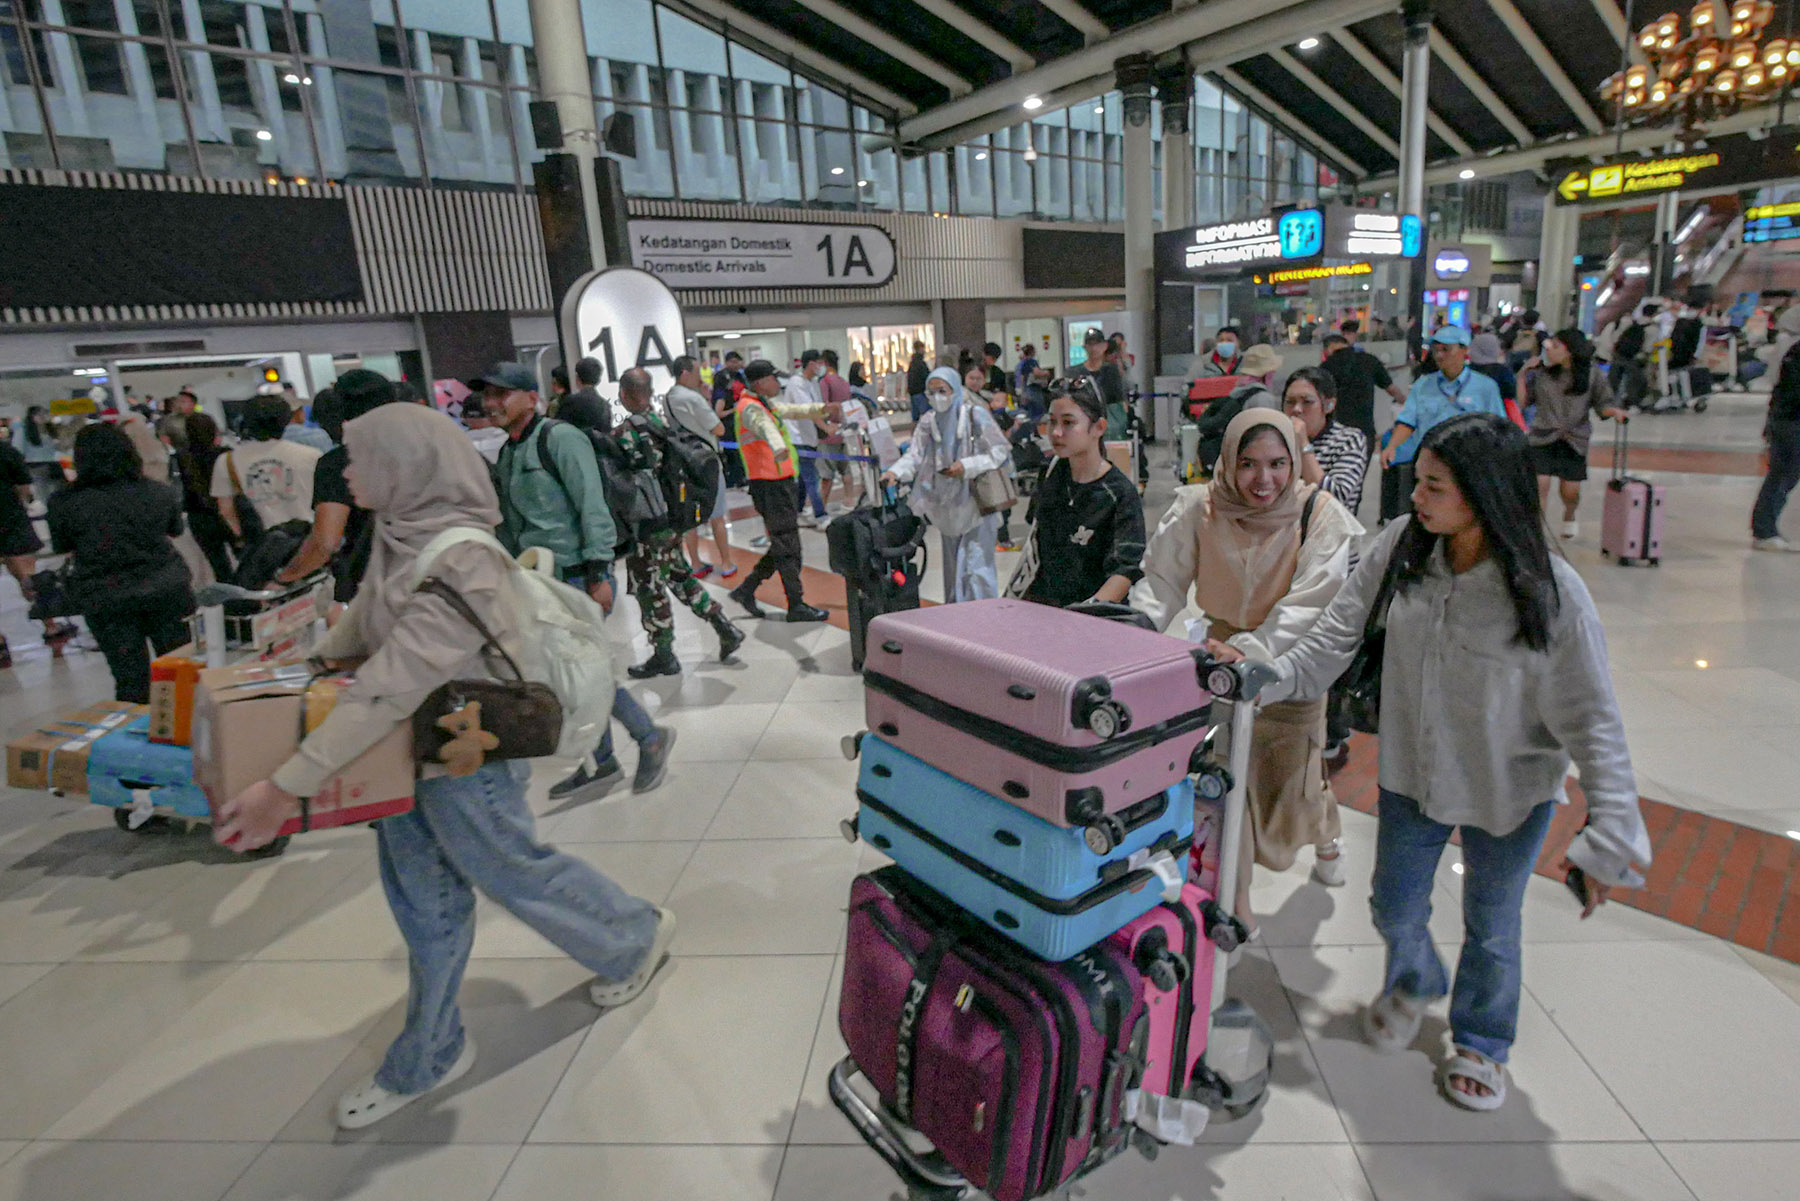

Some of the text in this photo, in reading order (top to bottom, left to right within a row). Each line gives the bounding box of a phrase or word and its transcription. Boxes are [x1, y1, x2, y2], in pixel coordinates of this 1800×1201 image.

[640, 235, 791, 252] Kedatangan Domestik
[817, 234, 874, 277] 1A
[643, 260, 767, 273] Domestic Arrivals
[588, 325, 676, 383] 1A
